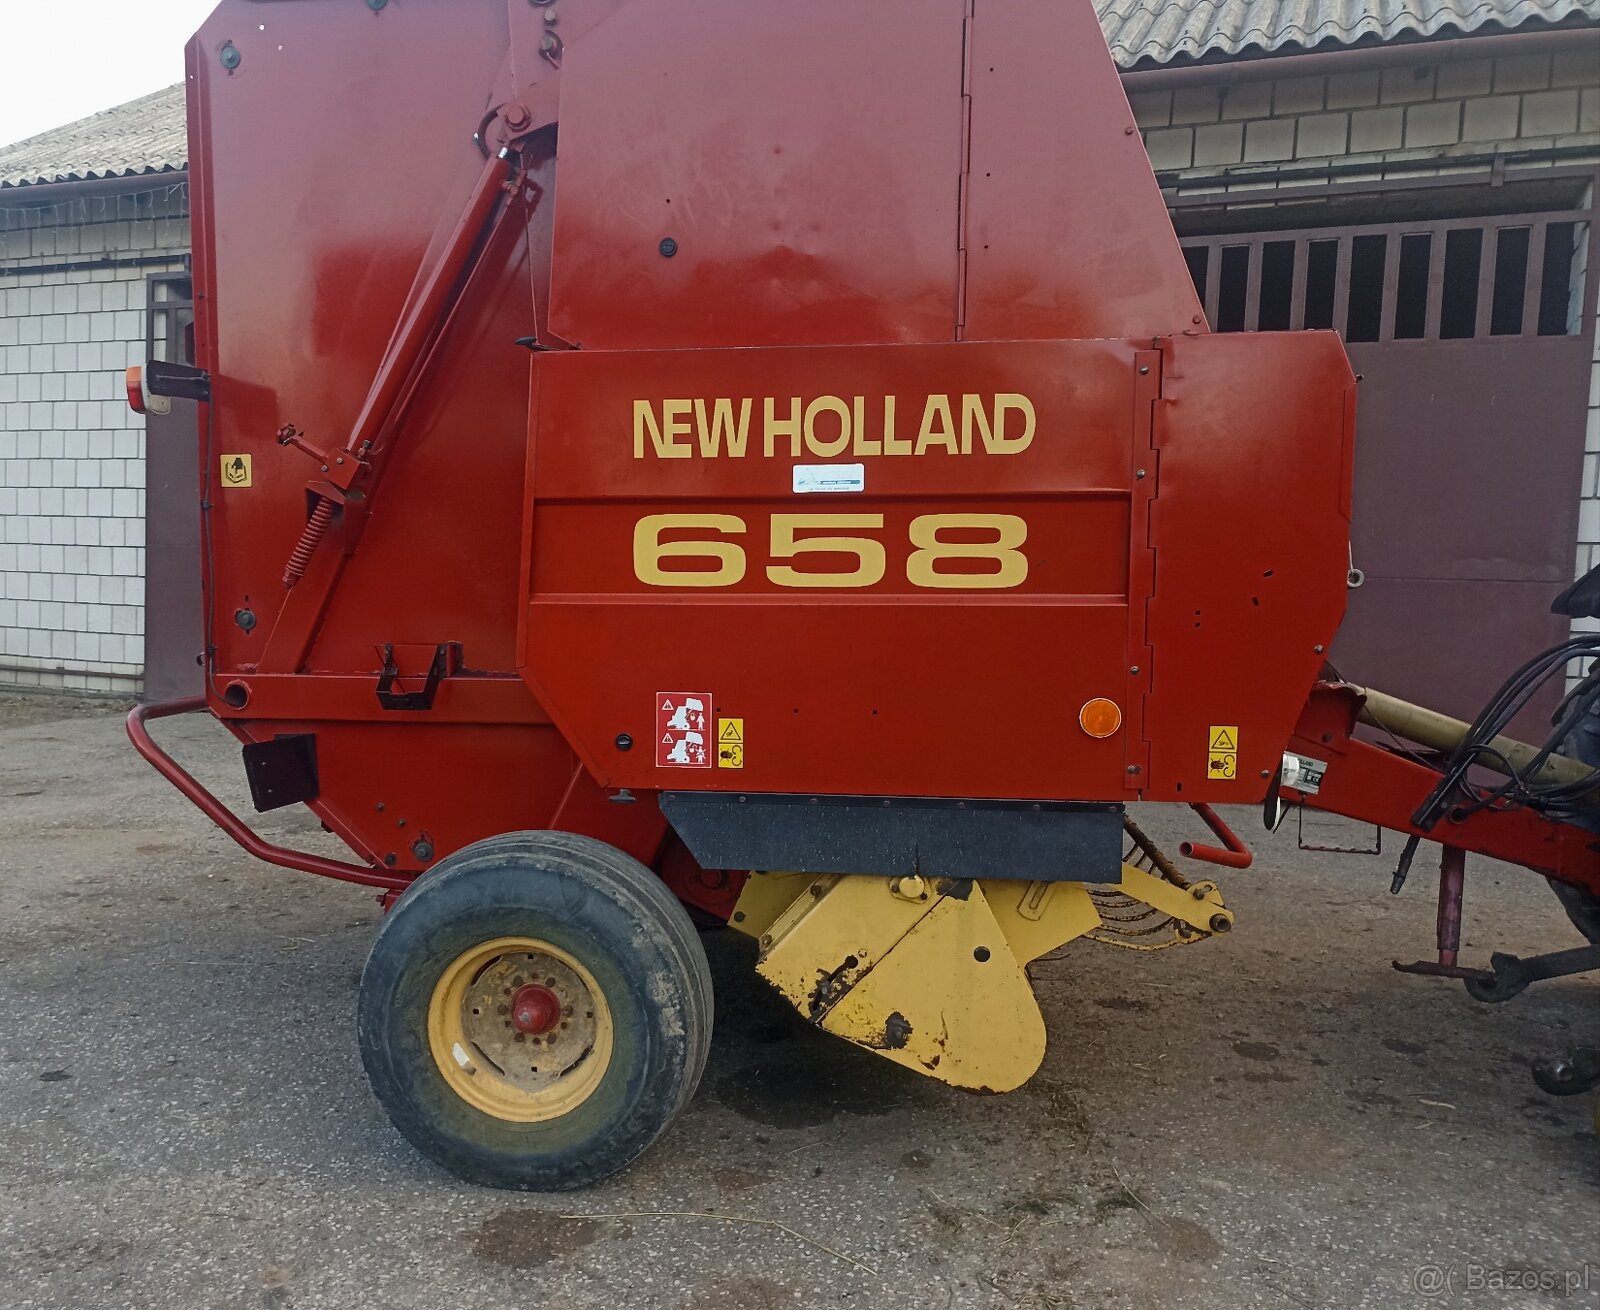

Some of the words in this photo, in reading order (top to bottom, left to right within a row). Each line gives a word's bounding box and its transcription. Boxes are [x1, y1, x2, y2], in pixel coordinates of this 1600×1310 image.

[633, 398, 752, 459] NEW
[763, 393, 1037, 458] HOLLAND
[633, 513, 1029, 588] 658
